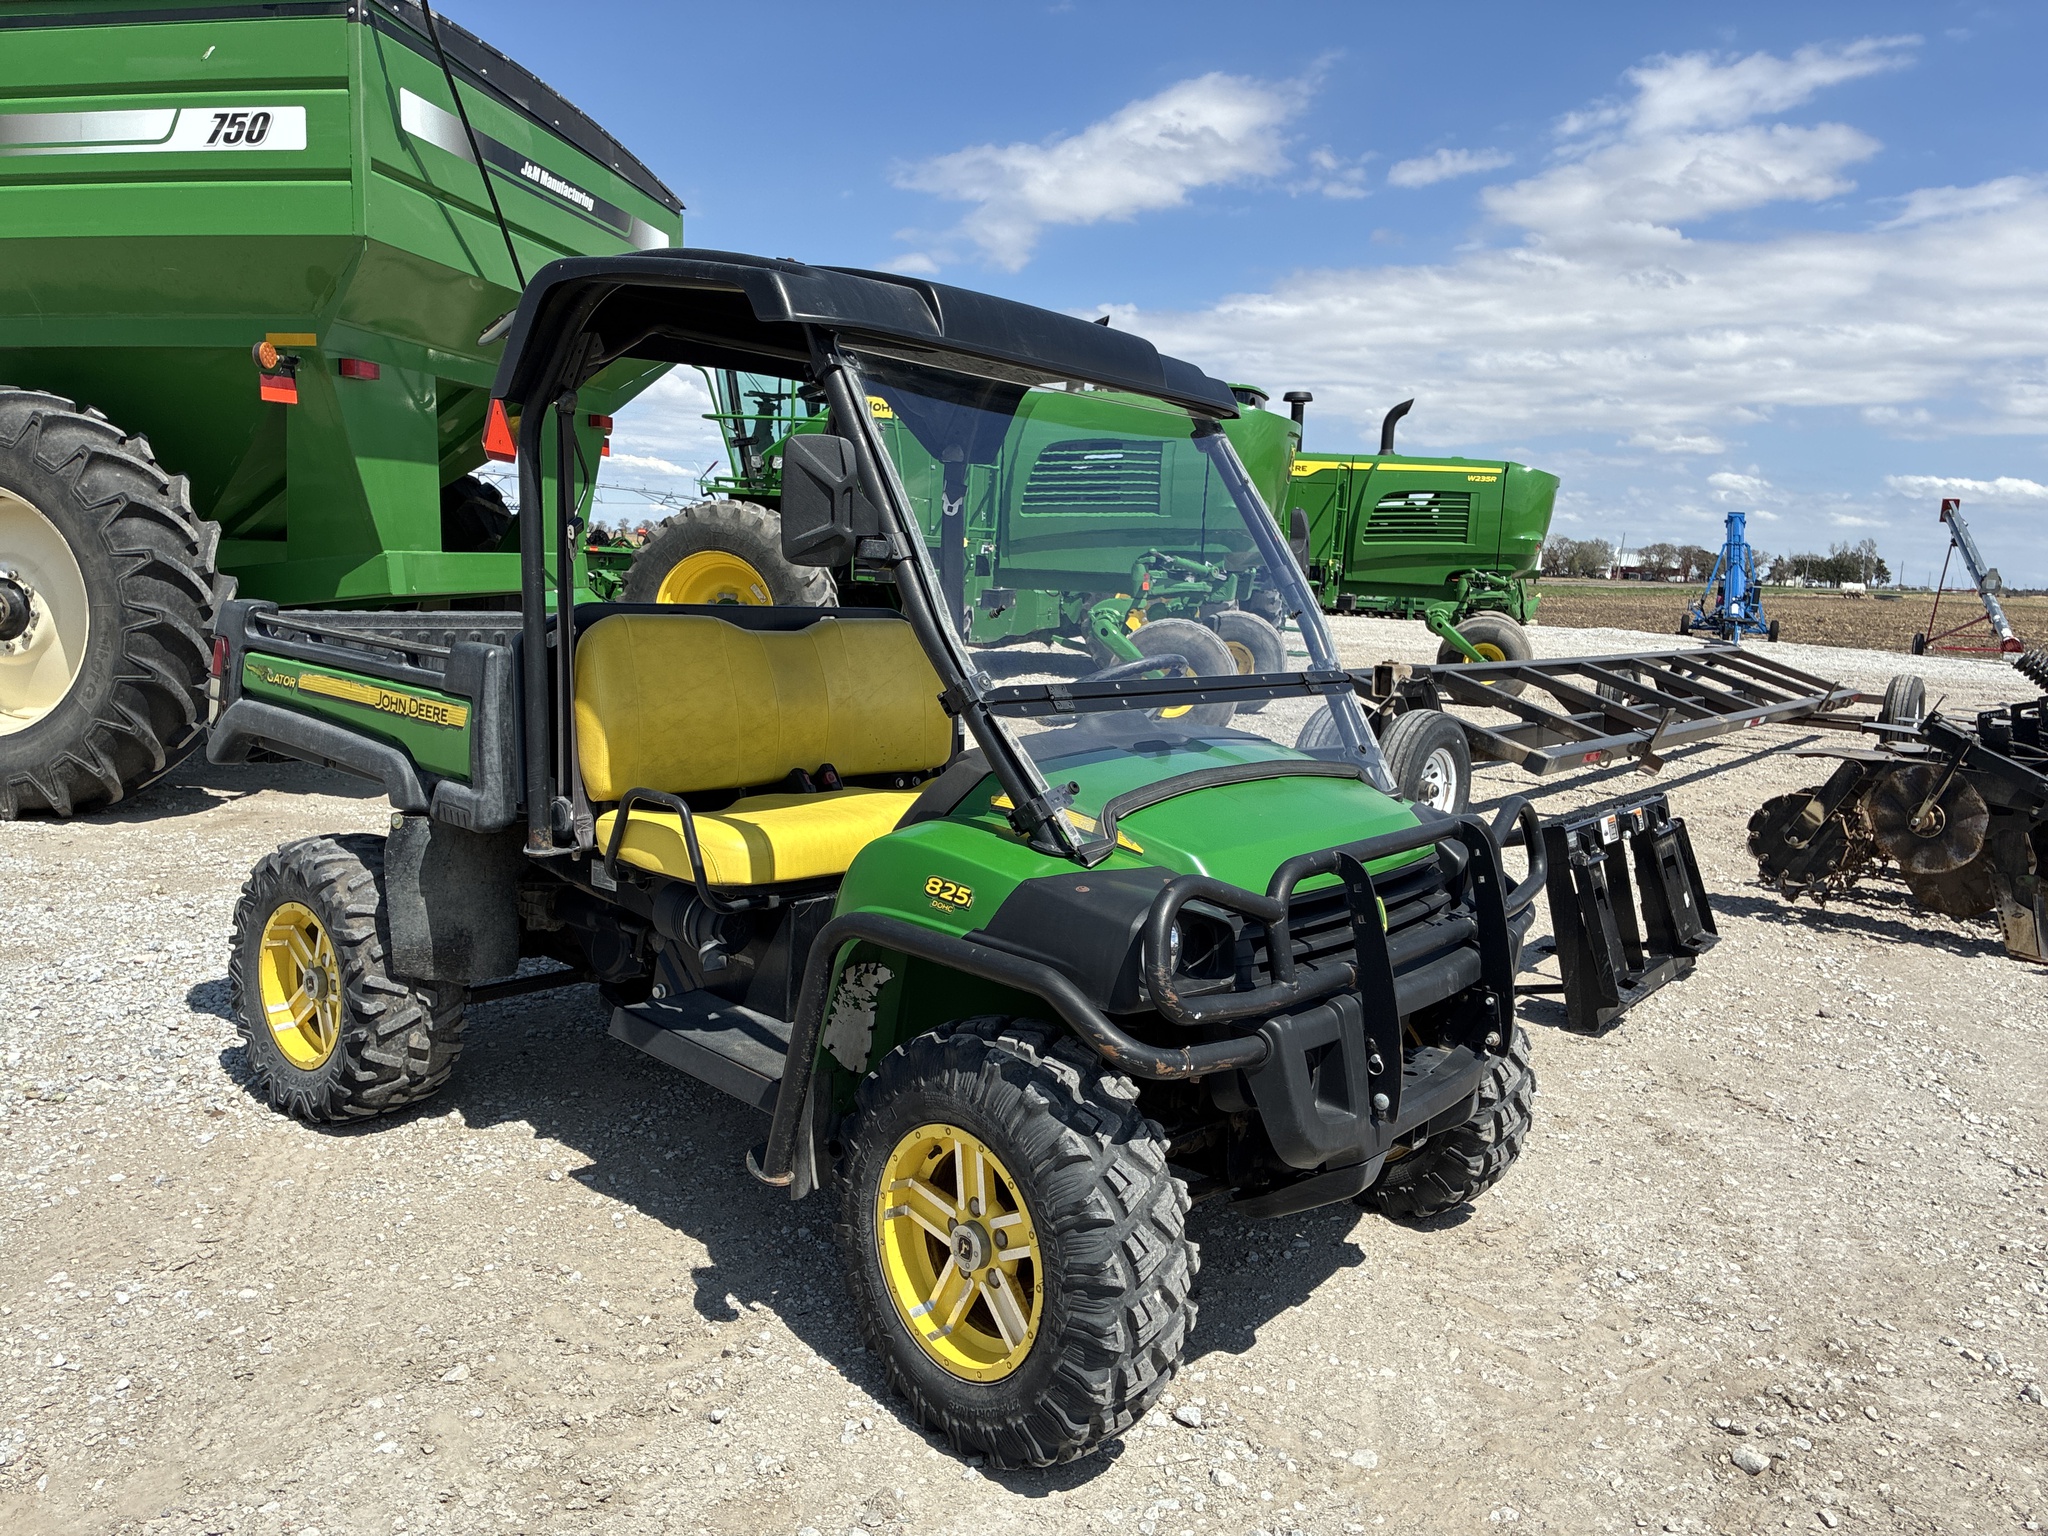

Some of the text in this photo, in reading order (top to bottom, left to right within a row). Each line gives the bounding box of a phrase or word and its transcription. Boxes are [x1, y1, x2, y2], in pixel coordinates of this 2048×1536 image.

[206, 112, 272, 145] 750
[521, 161, 594, 212] J&M Manufacturing
[1467, 475, 1497, 483] W235R
[267, 673, 296, 688] GATOR
[375, 690, 448, 723] JOHN DEERE
[925, 877, 973, 908] 825i
[931, 900, 954, 913] DOHC
